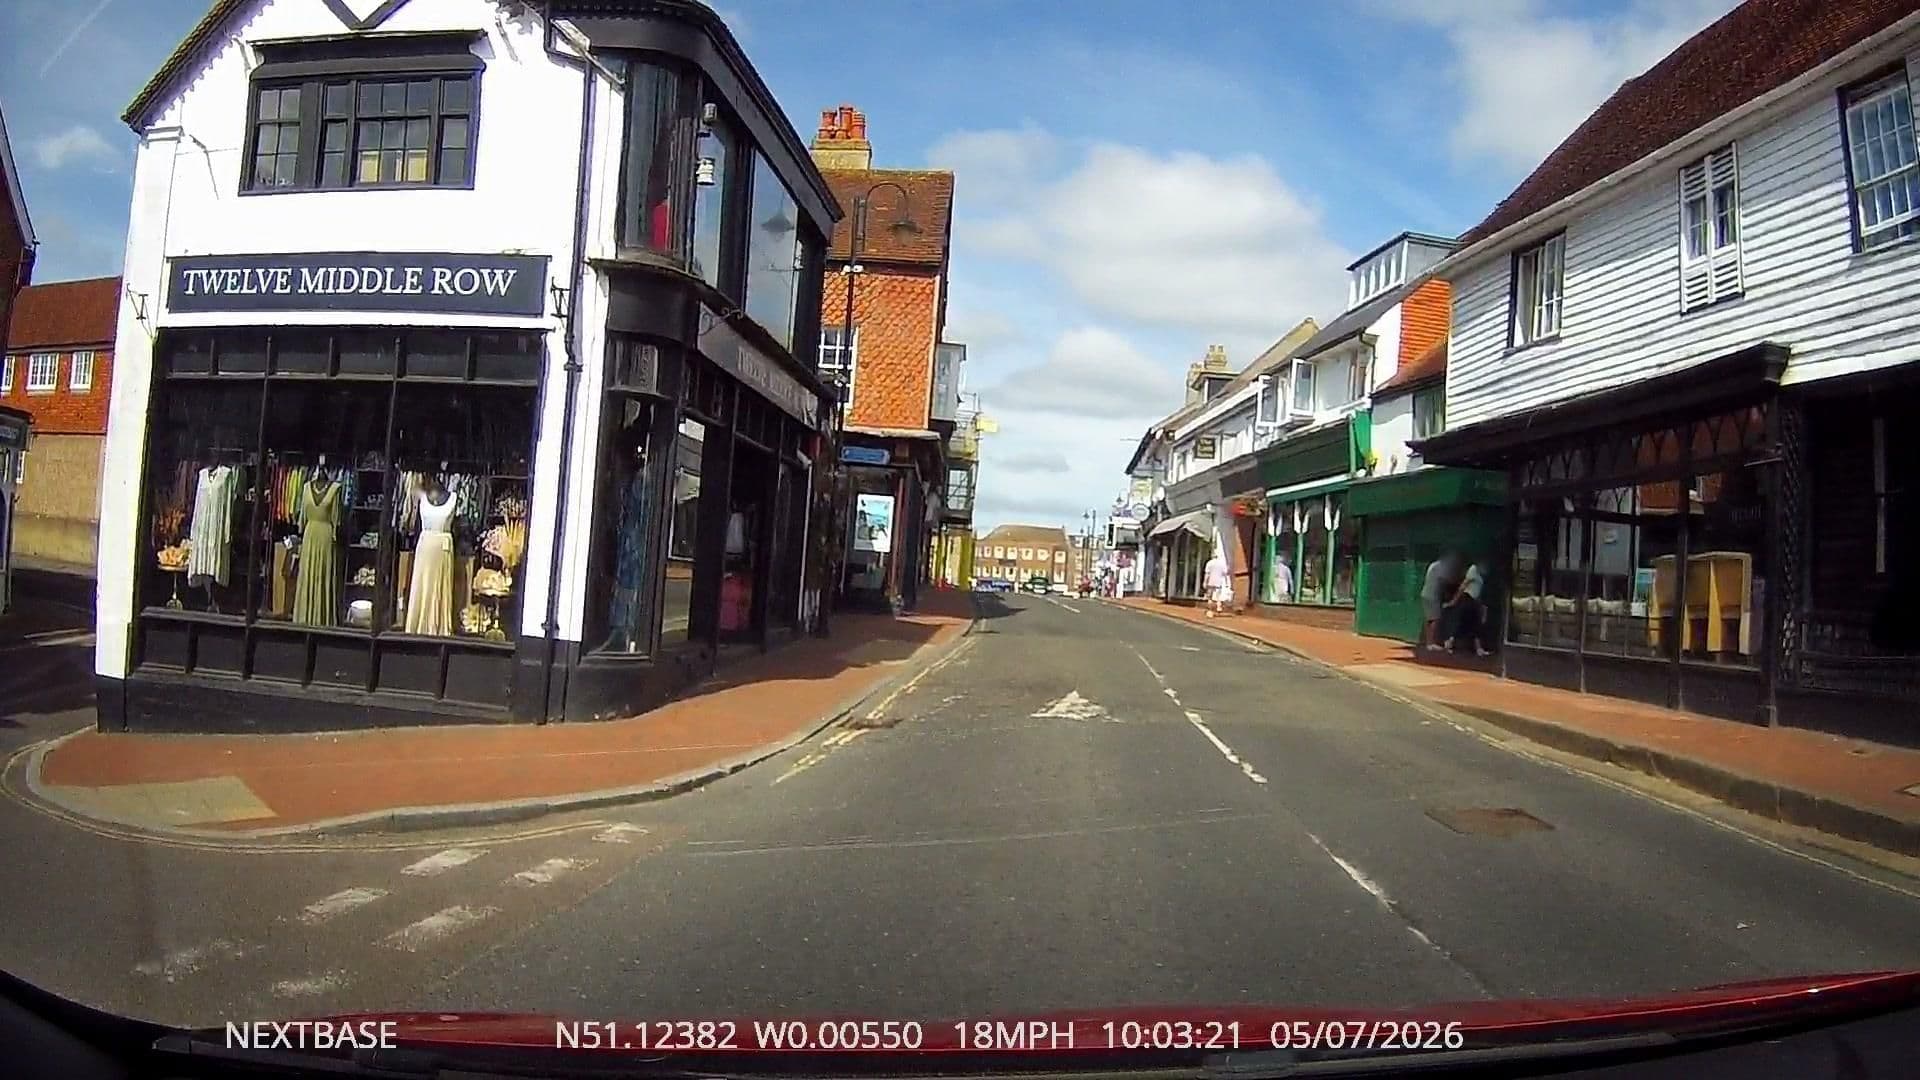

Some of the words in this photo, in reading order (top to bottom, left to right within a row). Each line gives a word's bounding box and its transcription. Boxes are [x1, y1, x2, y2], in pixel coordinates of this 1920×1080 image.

[183, 268, 292, 296] TWELVE
[297, 268, 424, 296] MIDDLE
[431, 267, 518, 297] ROW
